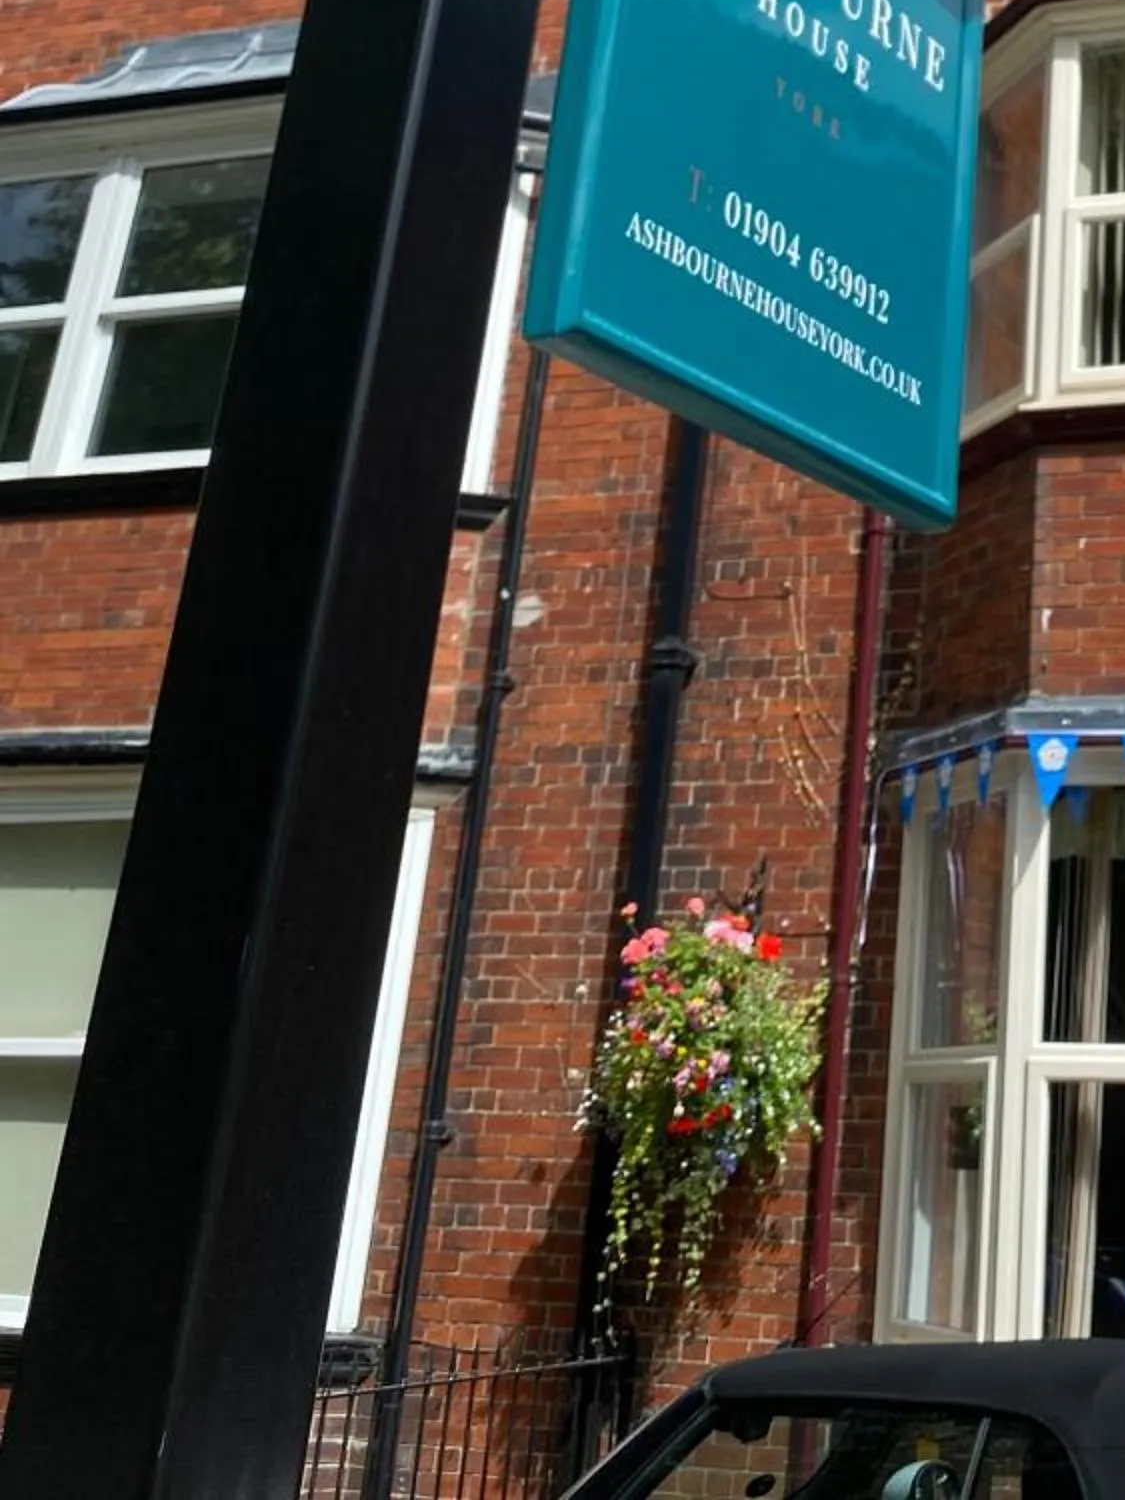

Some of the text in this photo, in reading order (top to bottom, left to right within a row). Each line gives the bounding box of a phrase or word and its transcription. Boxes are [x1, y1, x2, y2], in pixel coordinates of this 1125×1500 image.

[775, 74, 841, 141] YORK
[624, 211, 923, 406] ASHBOURNEHOUSEYORK.CO.UK
[723, 190, 801, 268] 01904
[809, 246, 891, 325] 639912
